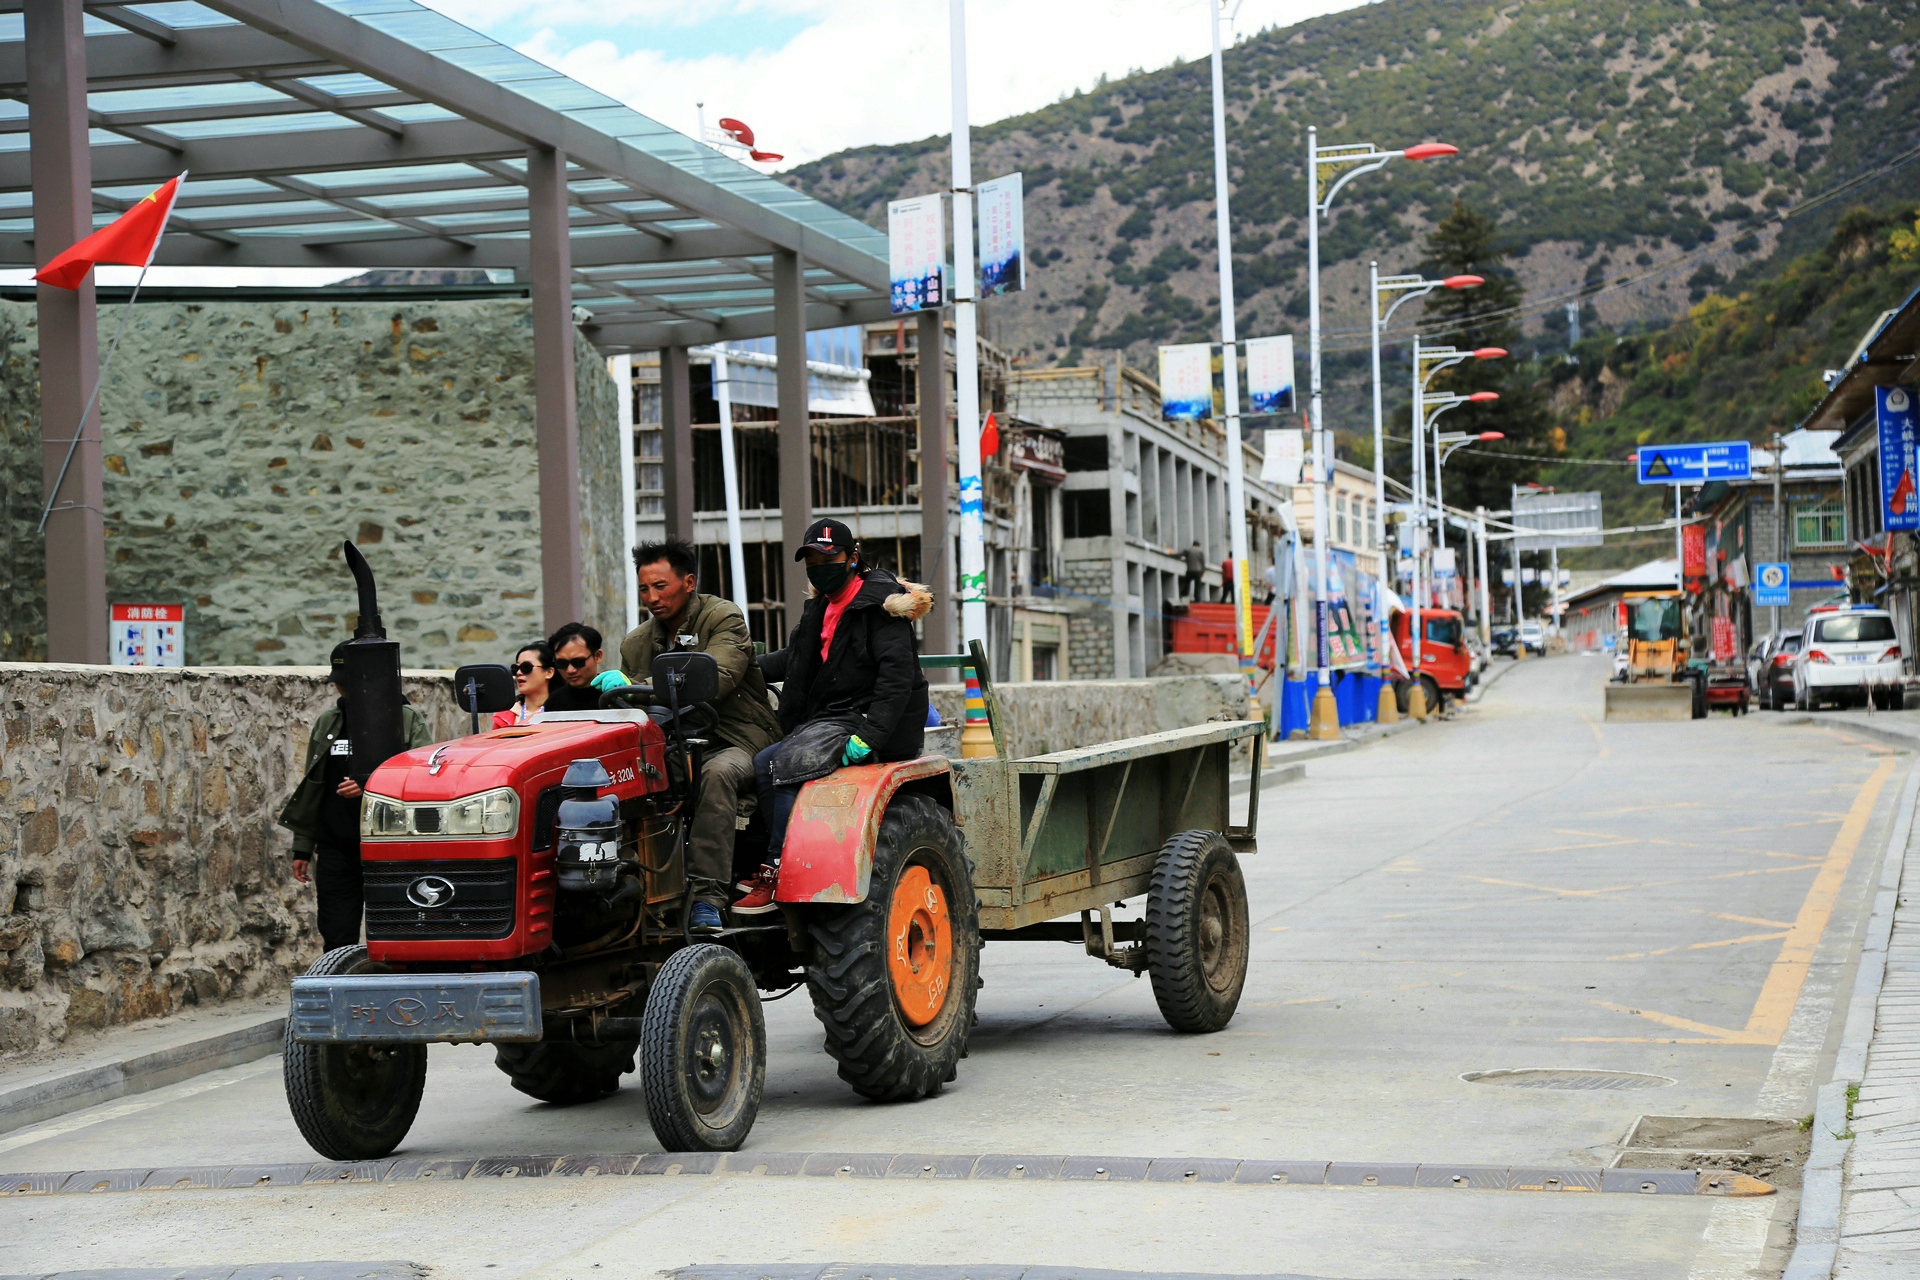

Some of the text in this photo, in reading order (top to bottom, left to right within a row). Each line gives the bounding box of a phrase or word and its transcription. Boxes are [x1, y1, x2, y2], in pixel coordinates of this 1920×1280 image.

[127, 606, 168, 619] 消防栓
[617, 767, 635, 783] 320A
[349, 1000, 464, 1023] 时 风
